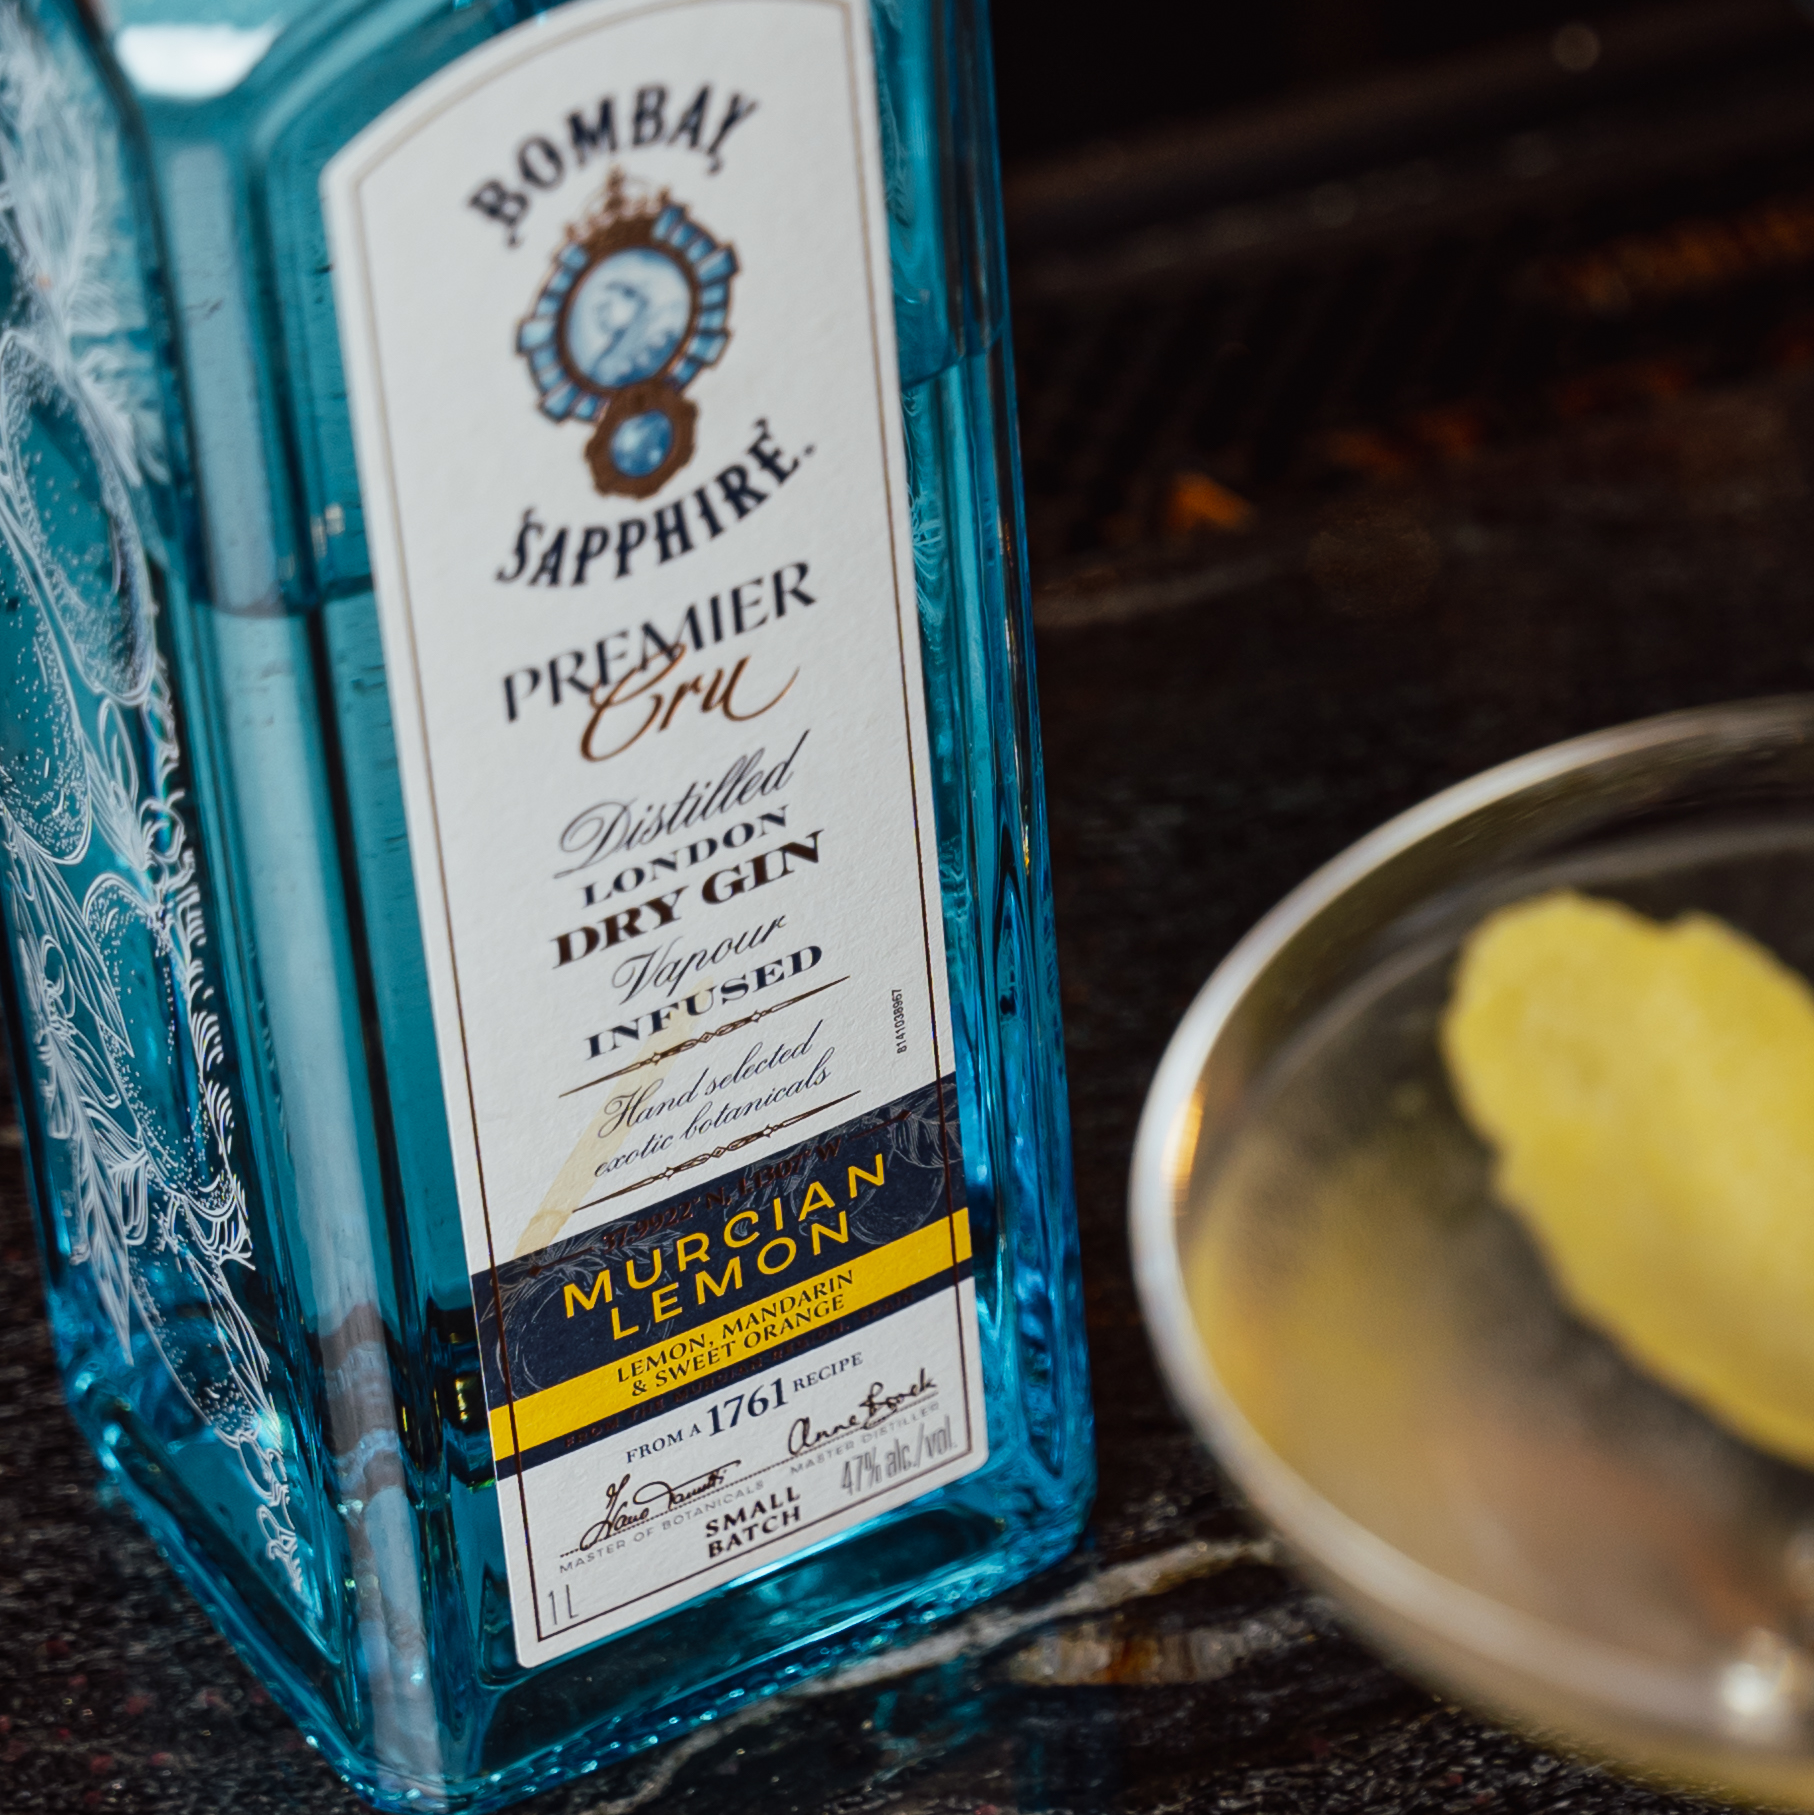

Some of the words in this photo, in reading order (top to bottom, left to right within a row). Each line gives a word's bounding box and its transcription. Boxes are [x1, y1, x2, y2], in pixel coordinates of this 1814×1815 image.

[468, 82, 759, 248] BOMBAY
[501, 561, 817, 722] PREMIER
[580, 643, 799, 762] Cru
[554, 729, 810, 879] Distilled
[580, 805, 790, 908] LONDON
[550, 886, 689, 968] DRY
[701, 830, 824, 904] GIN
[584, 945, 823, 1060] INFUSED
[611, 914, 786, 1006] Vapour
[594, 1132, 674, 1178] exotic
[681, 1046, 836, 1139] botanicals
[597, 1068, 709, 1139] Hand
[704, 1019, 824, 1096] selected
[562, 1153, 886, 1319] MURCIAN
[611, 1212, 850, 1341] LEMON
[617, 1334, 714, 1382] LEMON,
[722, 1270, 854, 1339] MANDARIN
[632, 1381, 647, 1397] &
[656, 1341, 736, 1388] SWEET
[744, 1294, 844, 1349] ORANGE
[564, 1419, 619, 1449] FROM
[630, 1398, 665, 1425] THE
[673, 1359, 763, 1403] MURCIAN
[626, 1428, 685, 1463] FROM
[689, 1423, 702, 1437] A
[707, 1378, 789, 1437] 1761
[793, 1352, 864, 1392] RECIPE
[790, 1441, 855, 1474] MASTER
[861, 1401, 939, 1444] DISTILLER
[560, 1539, 626, 1573] MASTER
[634, 1527, 654, 1542] OF
[662, 1480, 764, 1530] BOTANICALS
[705, 1486, 800, 1538] SMALL
[842, 1446, 882, 1495] 47%
[708, 1507, 800, 1559] BATCH
